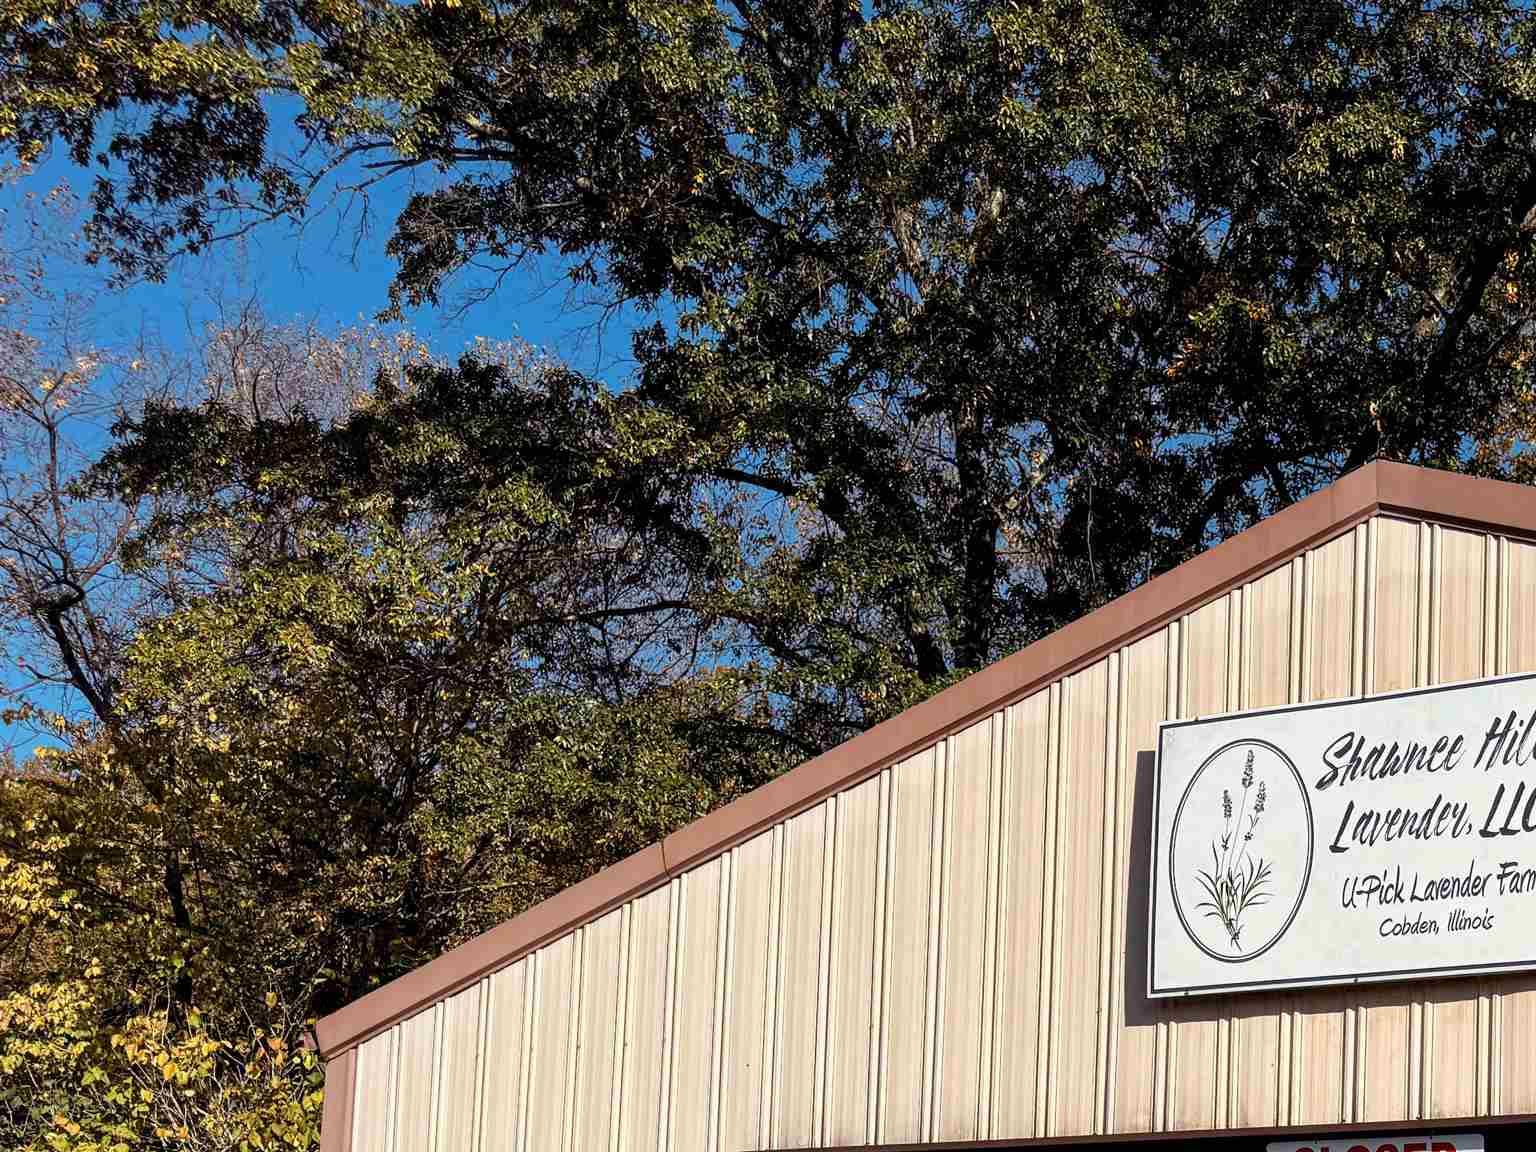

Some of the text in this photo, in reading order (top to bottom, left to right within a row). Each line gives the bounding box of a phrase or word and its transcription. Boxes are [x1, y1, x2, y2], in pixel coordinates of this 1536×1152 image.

[1315, 731, 1466, 791] Shawnee
[1329, 794, 1473, 853] Lavender,
[1342, 865, 1404, 908] U-Pick
[1410, 857, 1490, 902] Lavender
[1379, 908, 1495, 938] Cobden, Illinois
